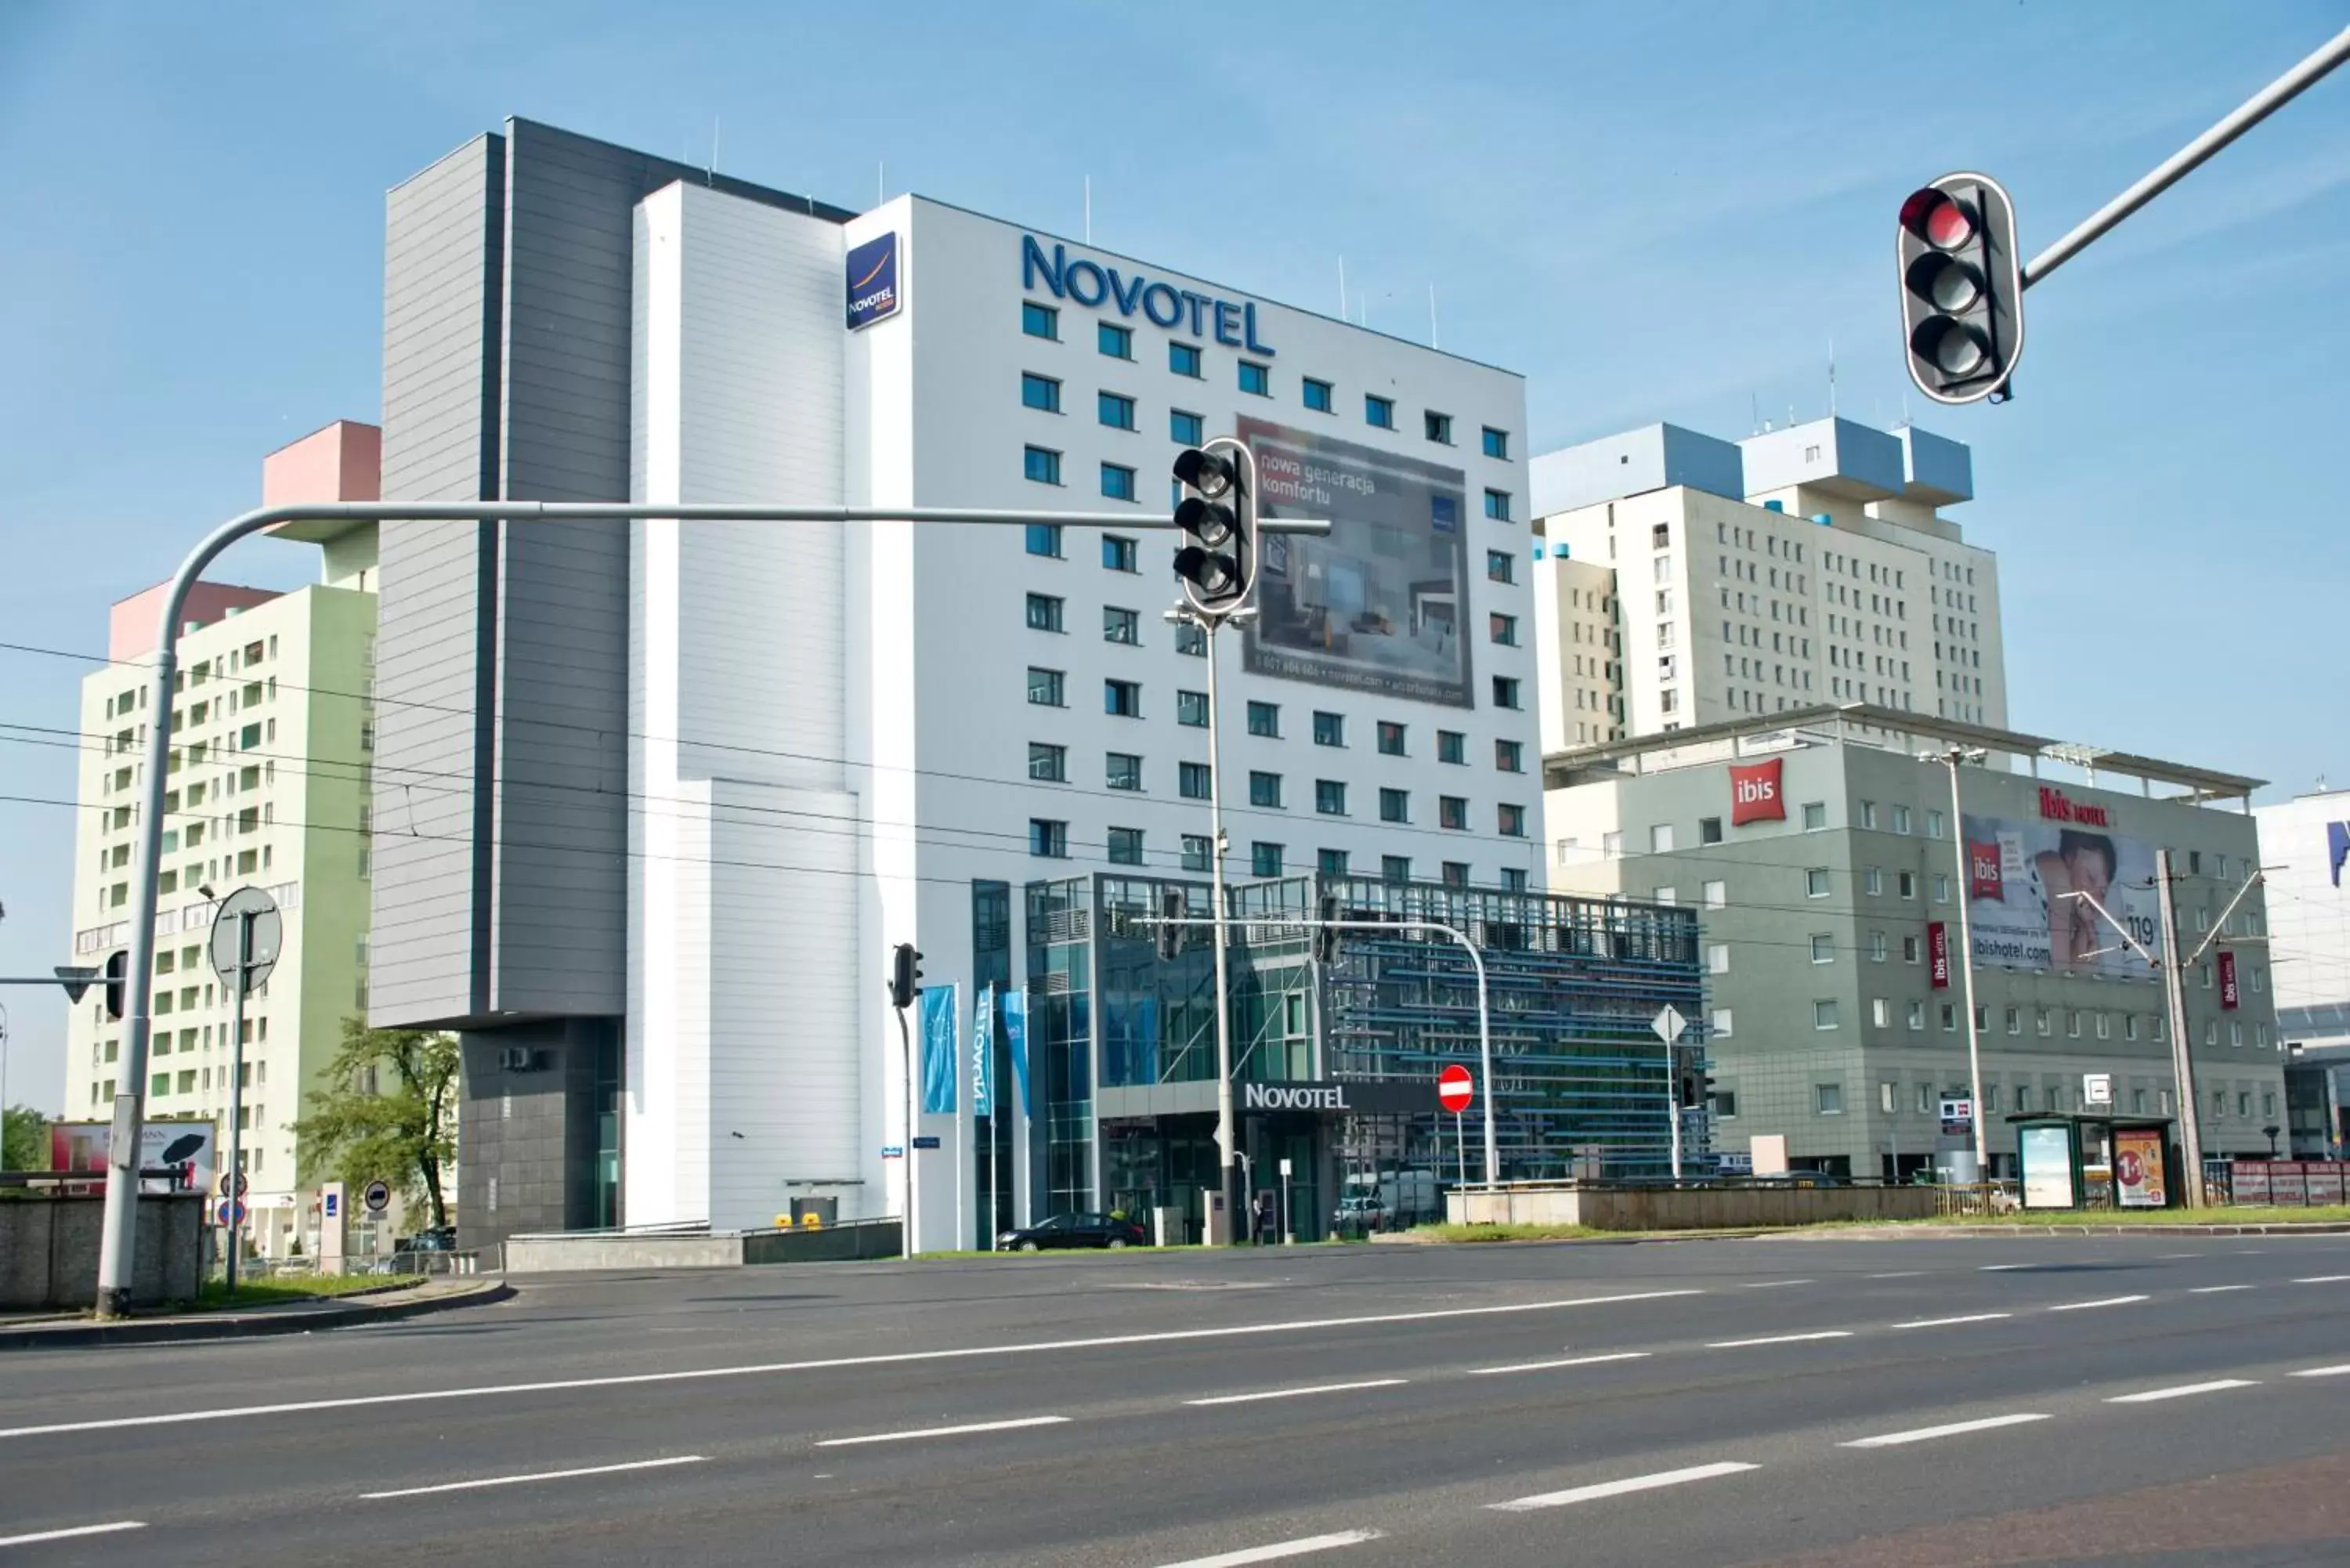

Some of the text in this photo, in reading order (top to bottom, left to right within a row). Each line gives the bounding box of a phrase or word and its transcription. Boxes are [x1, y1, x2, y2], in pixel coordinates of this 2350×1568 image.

[848, 285, 895, 316] NOVOTEL
[1022, 234, 1276, 357] NOVOTEL
[1261, 454, 1376, 496] nowa generacja
[1262, 473, 1330, 505] komfortu
[1738, 777, 1774, 803] ibis
[2039, 786, 2072, 822] ibis
[1974, 855, 1998, 881] ibis
[1972, 938, 2051, 961] ibishotel.com
[1934, 958, 1947, 980] ibis
[1245, 1082, 1351, 1109] NOVOTEL
